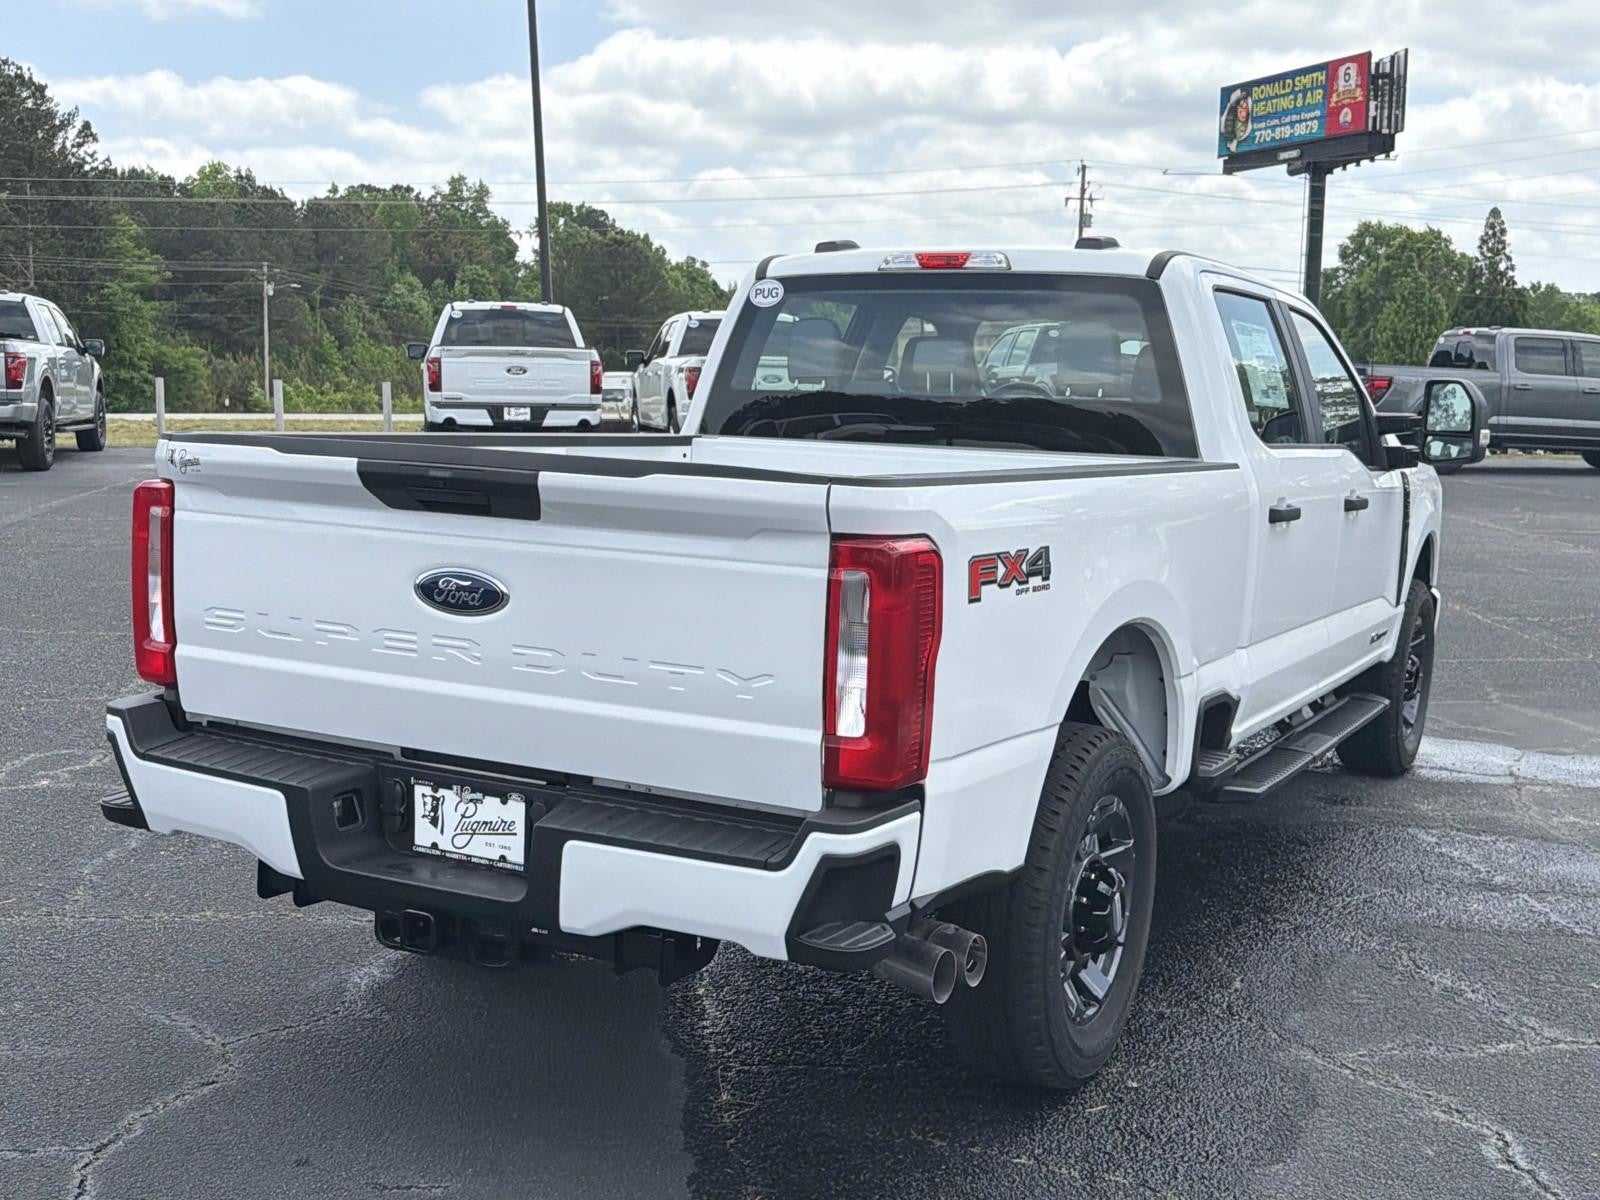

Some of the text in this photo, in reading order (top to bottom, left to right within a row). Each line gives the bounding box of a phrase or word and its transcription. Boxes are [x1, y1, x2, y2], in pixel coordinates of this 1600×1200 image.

[1252, 70, 1326, 100] RONALD SMITH
[1343, 66, 1351, 83] 6
[1253, 95, 1294, 117] HEATING
[1296, 93, 1303, 107] &
[1305, 89, 1324, 106] AIR
[1254, 120, 1318, 144] 770-819-9879
[754, 287, 780, 299] PUG
[967, 545, 1051, 605] FX4
[1015, 583, 1051, 596] OFF ROAD
[203, 606, 775, 700] SUPER DUTY
[451, 799, 518, 850] Pugmire
